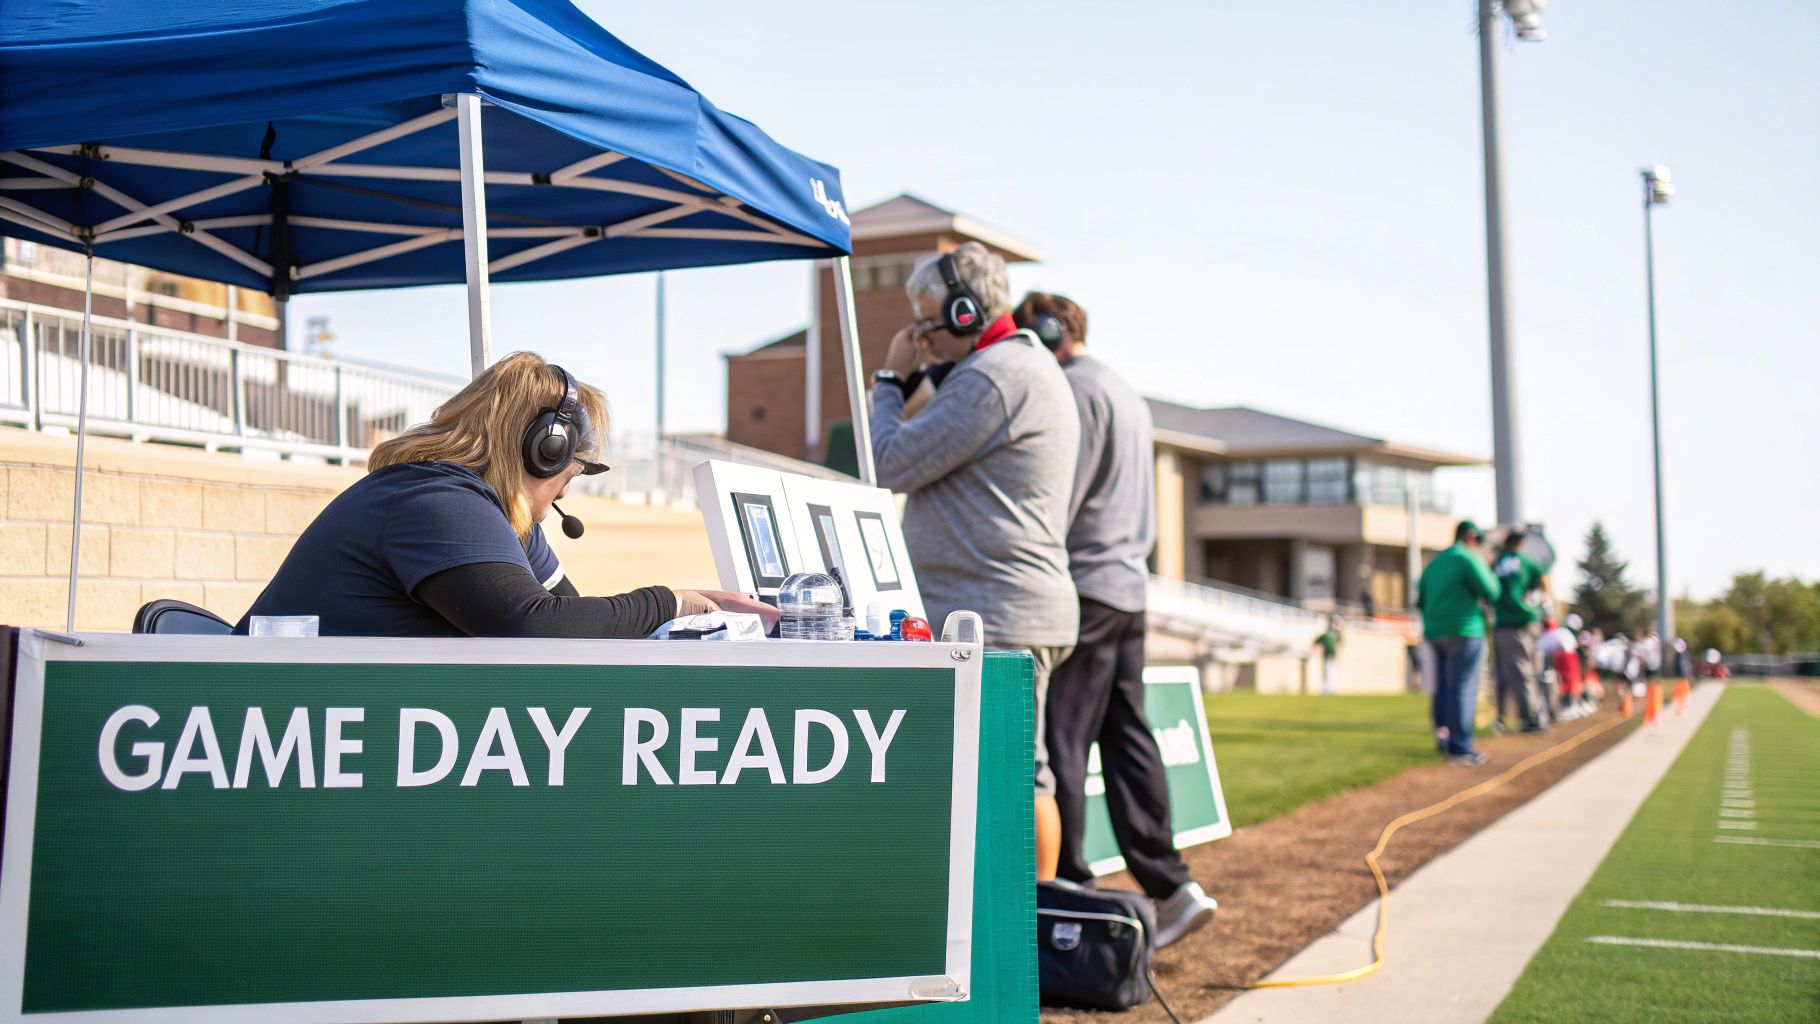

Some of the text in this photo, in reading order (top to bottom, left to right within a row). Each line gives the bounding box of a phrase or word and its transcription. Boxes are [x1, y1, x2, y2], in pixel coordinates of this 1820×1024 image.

[98, 705, 908, 792] GAME DAY READY
